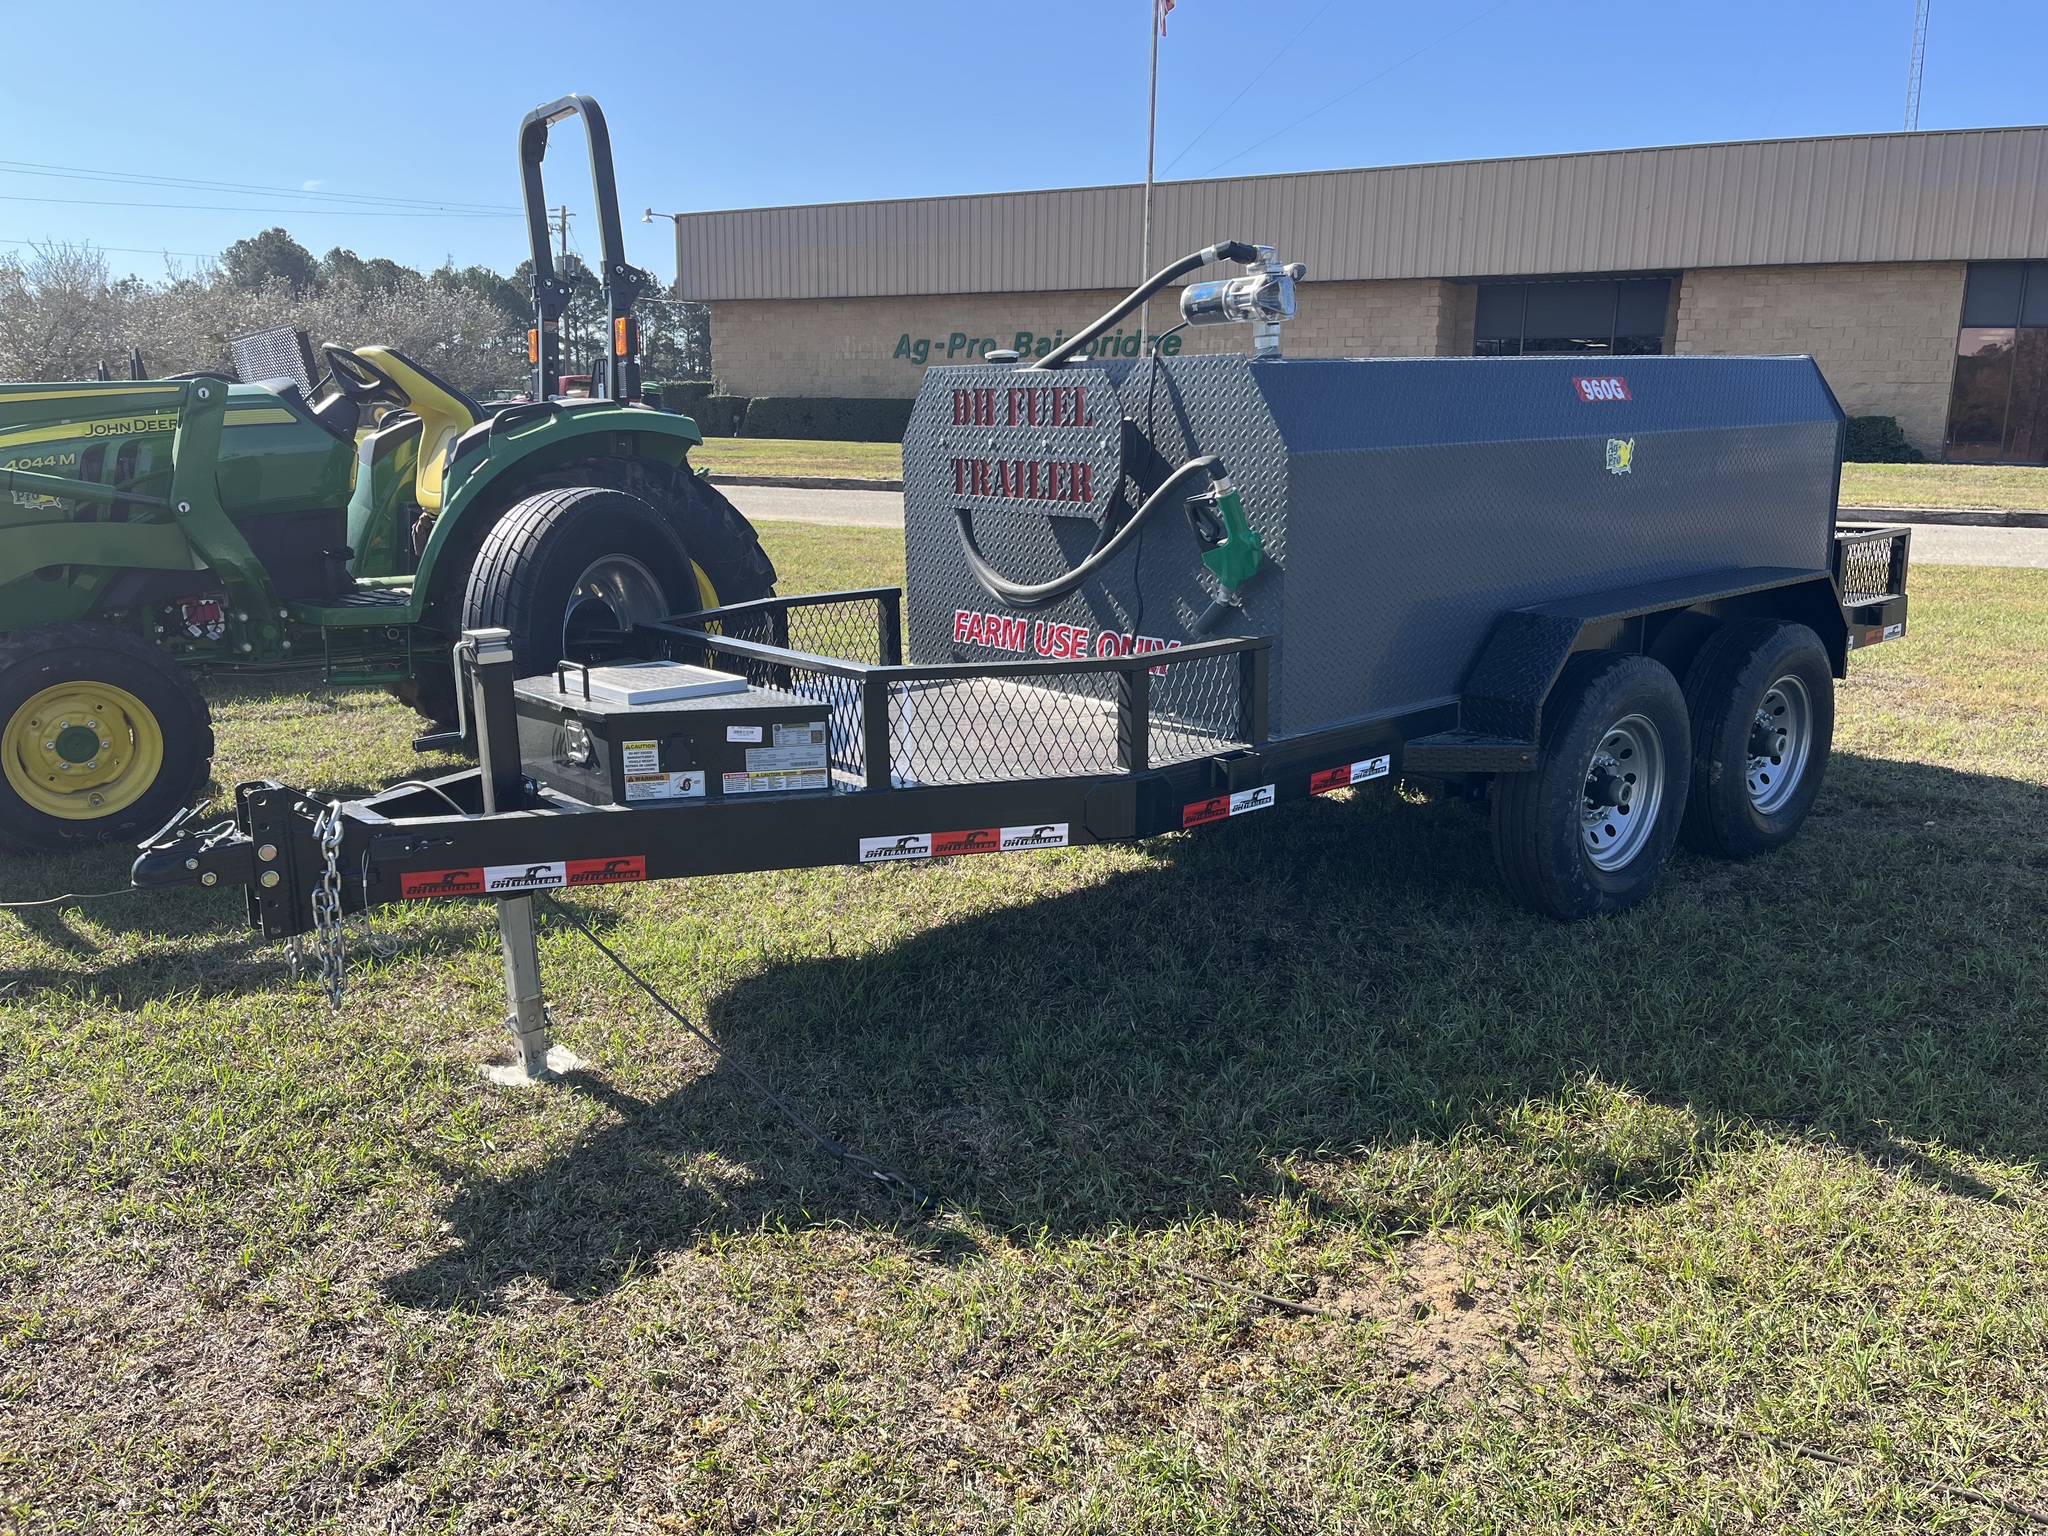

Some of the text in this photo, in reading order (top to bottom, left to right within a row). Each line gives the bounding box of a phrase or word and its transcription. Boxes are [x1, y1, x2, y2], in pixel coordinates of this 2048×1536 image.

[892, 332, 997, 365] Ag-Pro
[1581, 379, 1625, 400] 960G
[952, 386, 1093, 428] DH FUEL
[84, 419, 178, 437] JOHN DEER
[4, 453, 76, 471] 4044 M
[950, 458, 1094, 503] TRAILER
[953, 609, 1027, 653] FARM
[1034, 620, 1088, 659] USE
[512, 876, 562, 887] TRAILERS
